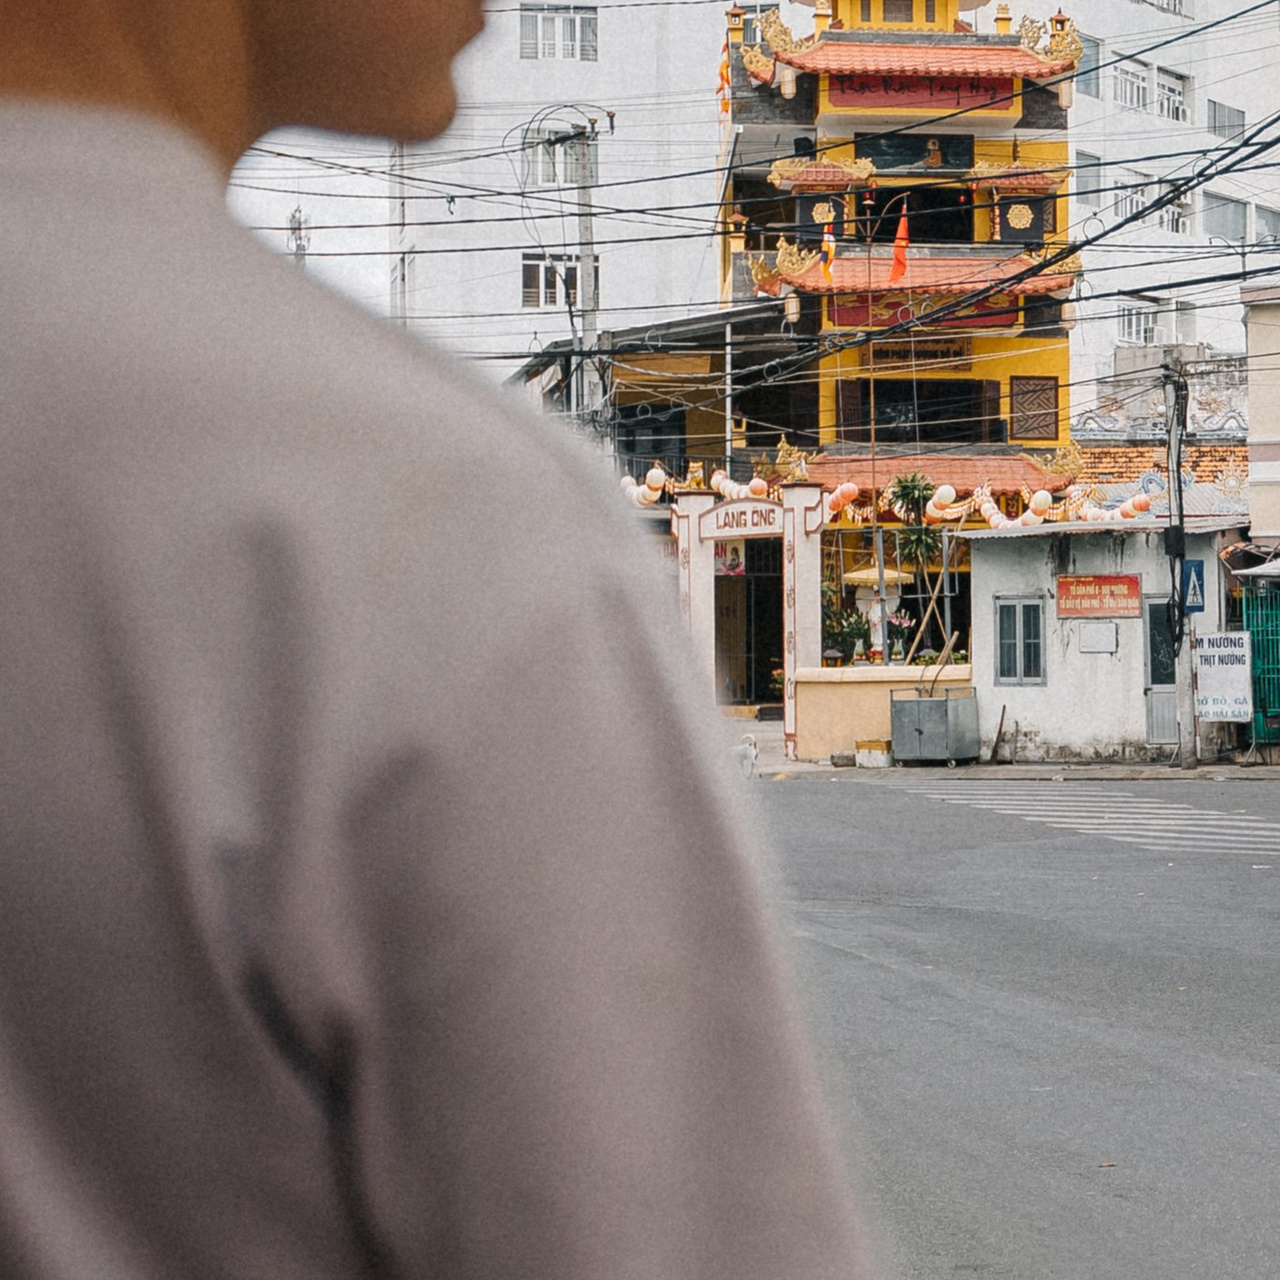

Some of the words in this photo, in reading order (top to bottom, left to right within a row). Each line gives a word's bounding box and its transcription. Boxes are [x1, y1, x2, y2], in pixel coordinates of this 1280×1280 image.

[1208, 634, 1244, 649] NƯỚNG
[1199, 654, 1216, 667] THỊT
[1218, 651, 1246, 666] NƯỚNG
